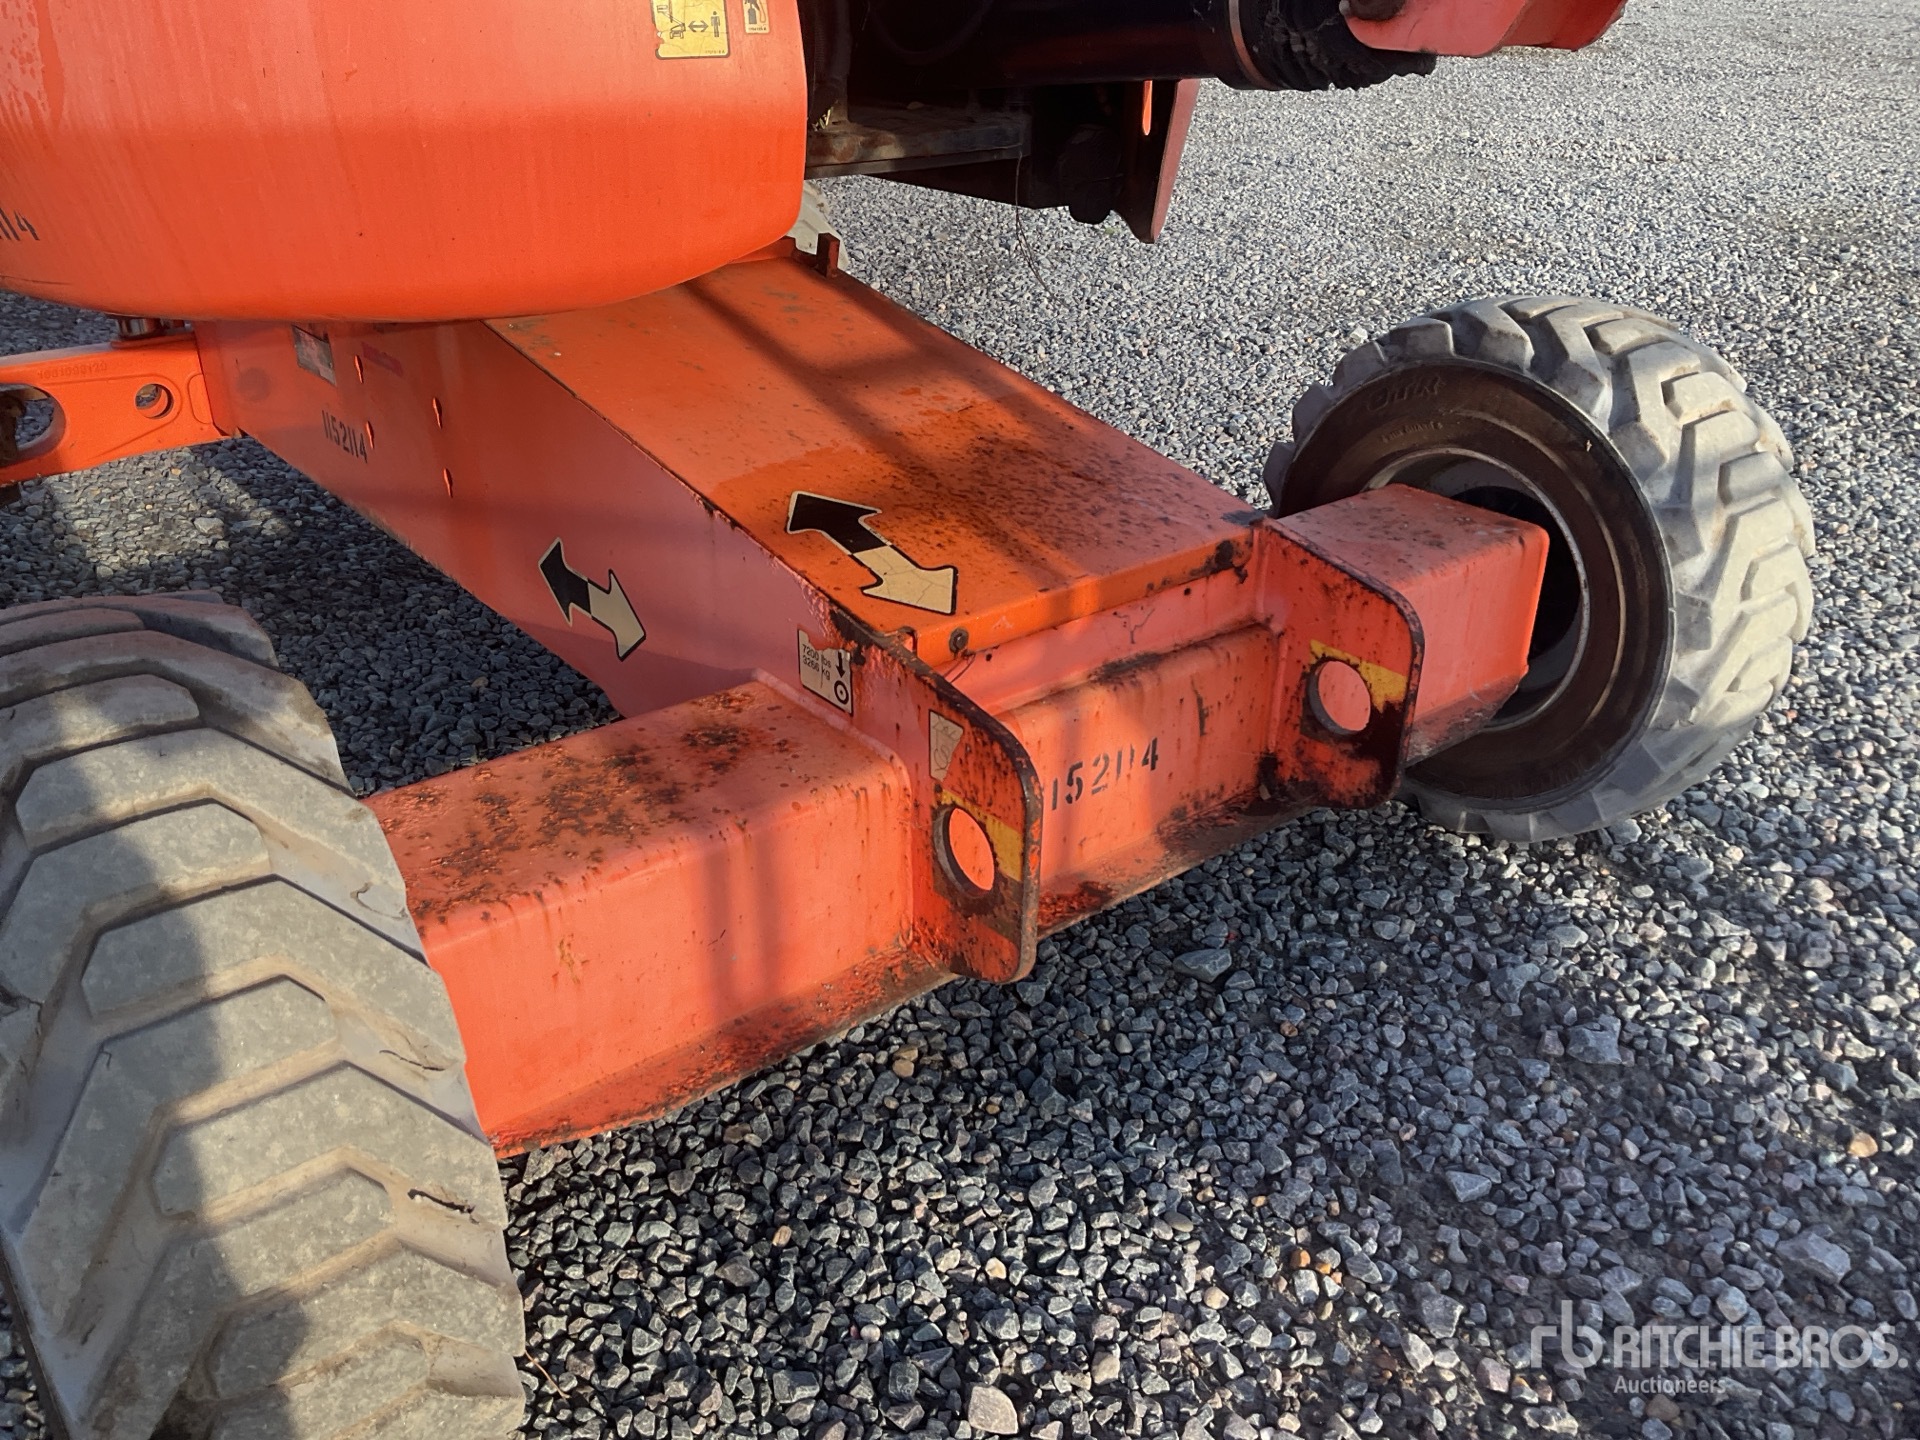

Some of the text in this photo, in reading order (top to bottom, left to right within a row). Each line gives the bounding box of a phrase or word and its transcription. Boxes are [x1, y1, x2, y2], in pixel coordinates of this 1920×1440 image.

[0, 208, 41, 242] 114
[321, 409, 368, 465] 1152114
[802, 643, 832, 669] 7200 lbs
[821, 665, 831, 681] kg
